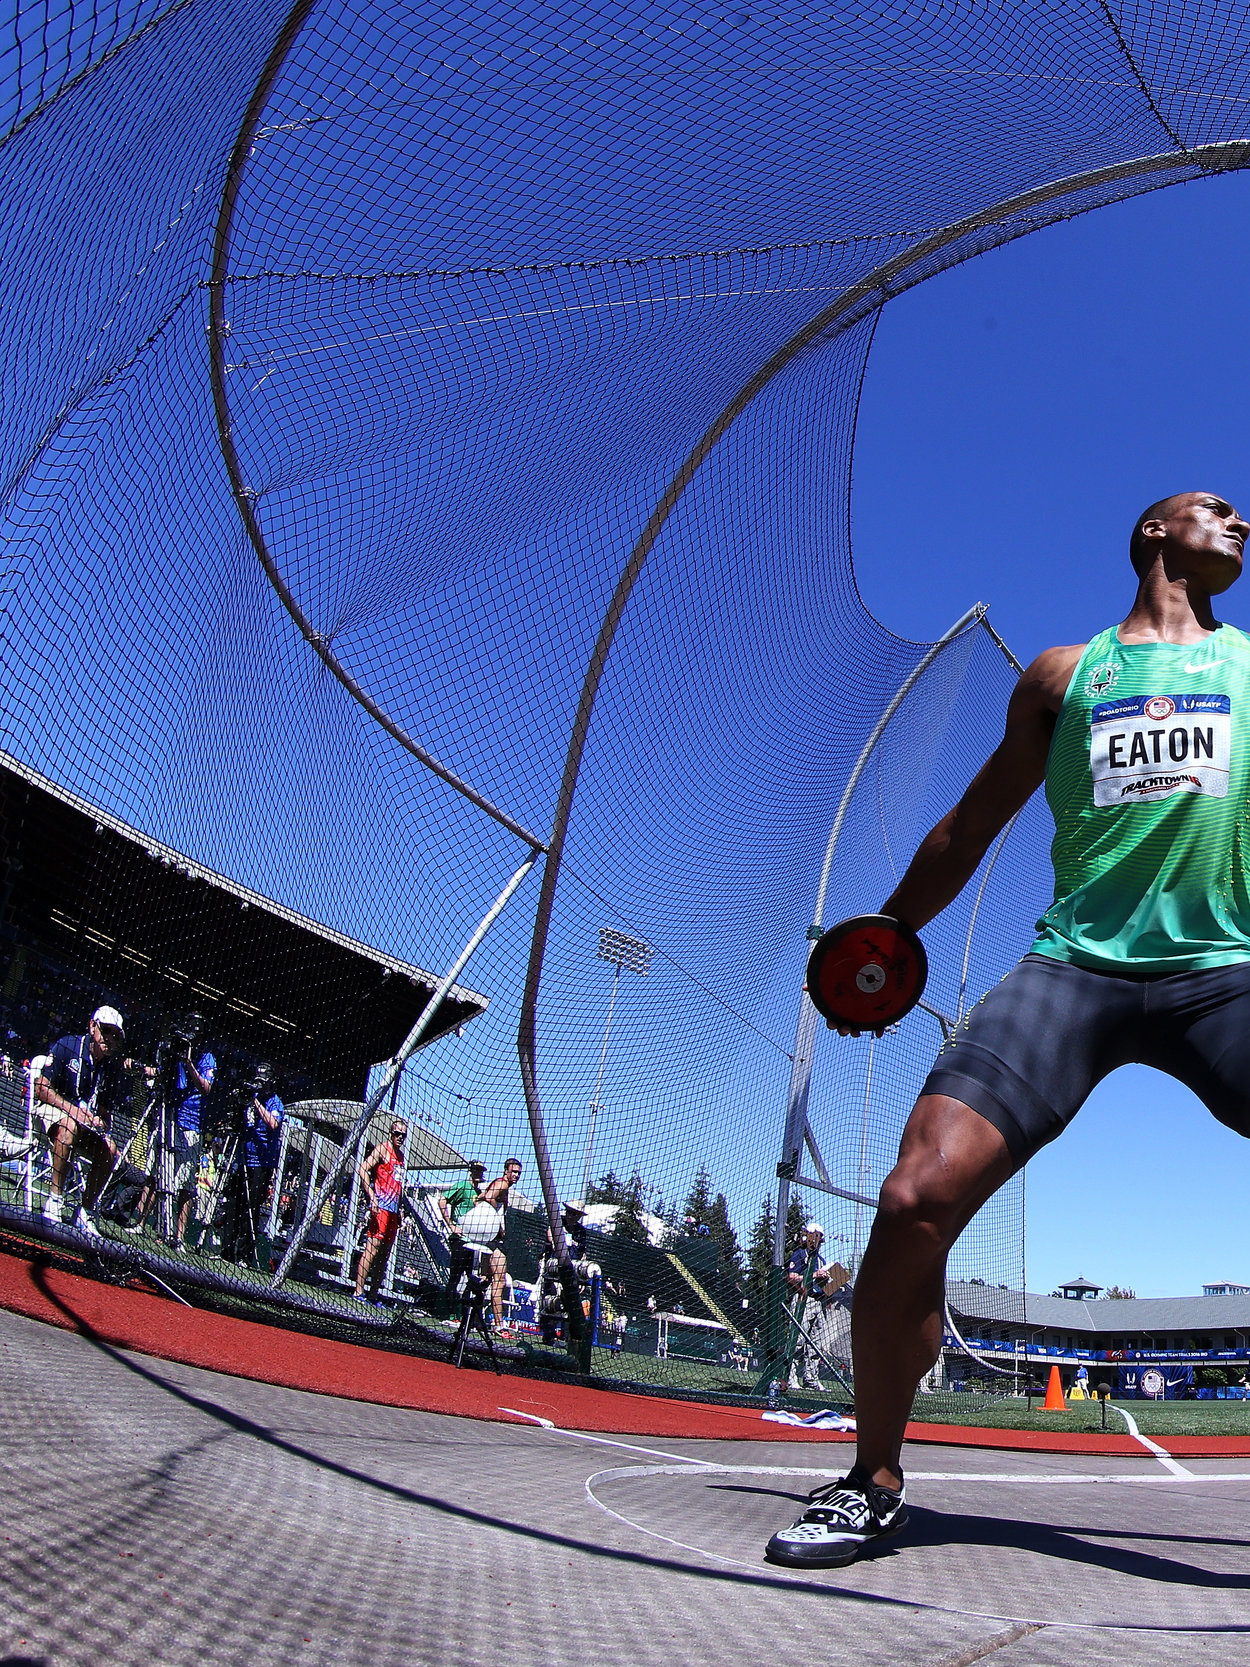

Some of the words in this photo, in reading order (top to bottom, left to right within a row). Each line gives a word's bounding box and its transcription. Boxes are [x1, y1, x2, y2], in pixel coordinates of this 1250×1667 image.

[1098, 704, 1139, 717] #ROADTORIO
[1195, 701, 1222, 709] USATF
[1109, 727, 1213, 769] EATON
[820, 1490, 866, 1516] NIKE
